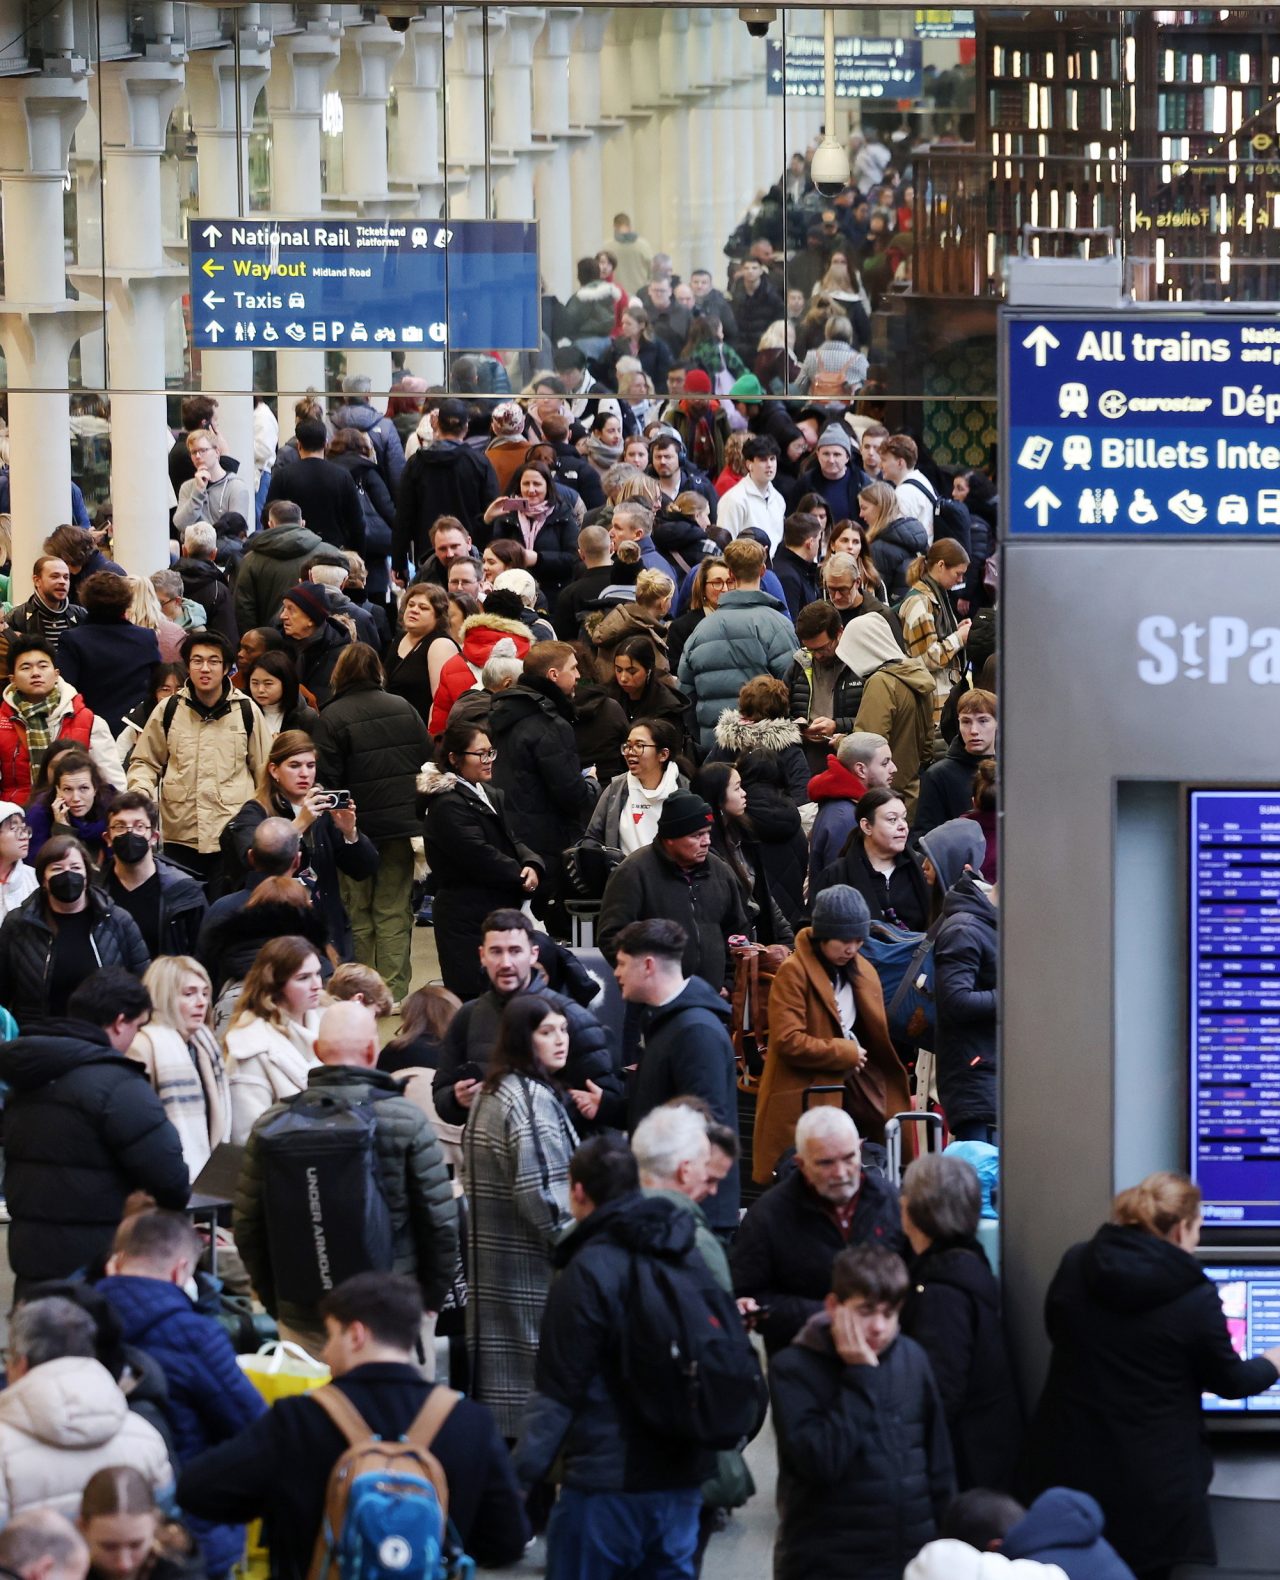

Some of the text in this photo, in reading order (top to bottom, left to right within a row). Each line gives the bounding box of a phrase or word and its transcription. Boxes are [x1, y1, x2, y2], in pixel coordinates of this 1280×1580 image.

[231, 228, 351, 247] National Rail
[356, 226, 406, 238] Tickets and
[356, 237, 400, 249] platforms
[233, 260, 307, 281] Way out
[312, 268, 372, 278] Midland Road
[233, 291, 283, 309] Taxis
[1077, 331, 1231, 363] All trains
[1241, 345, 1271, 363] and
[1128, 396, 1213, 413] eurostar
[1101, 438, 1208, 469] Billets
[305, 1167, 334, 1291] UNDER ARMOUR
